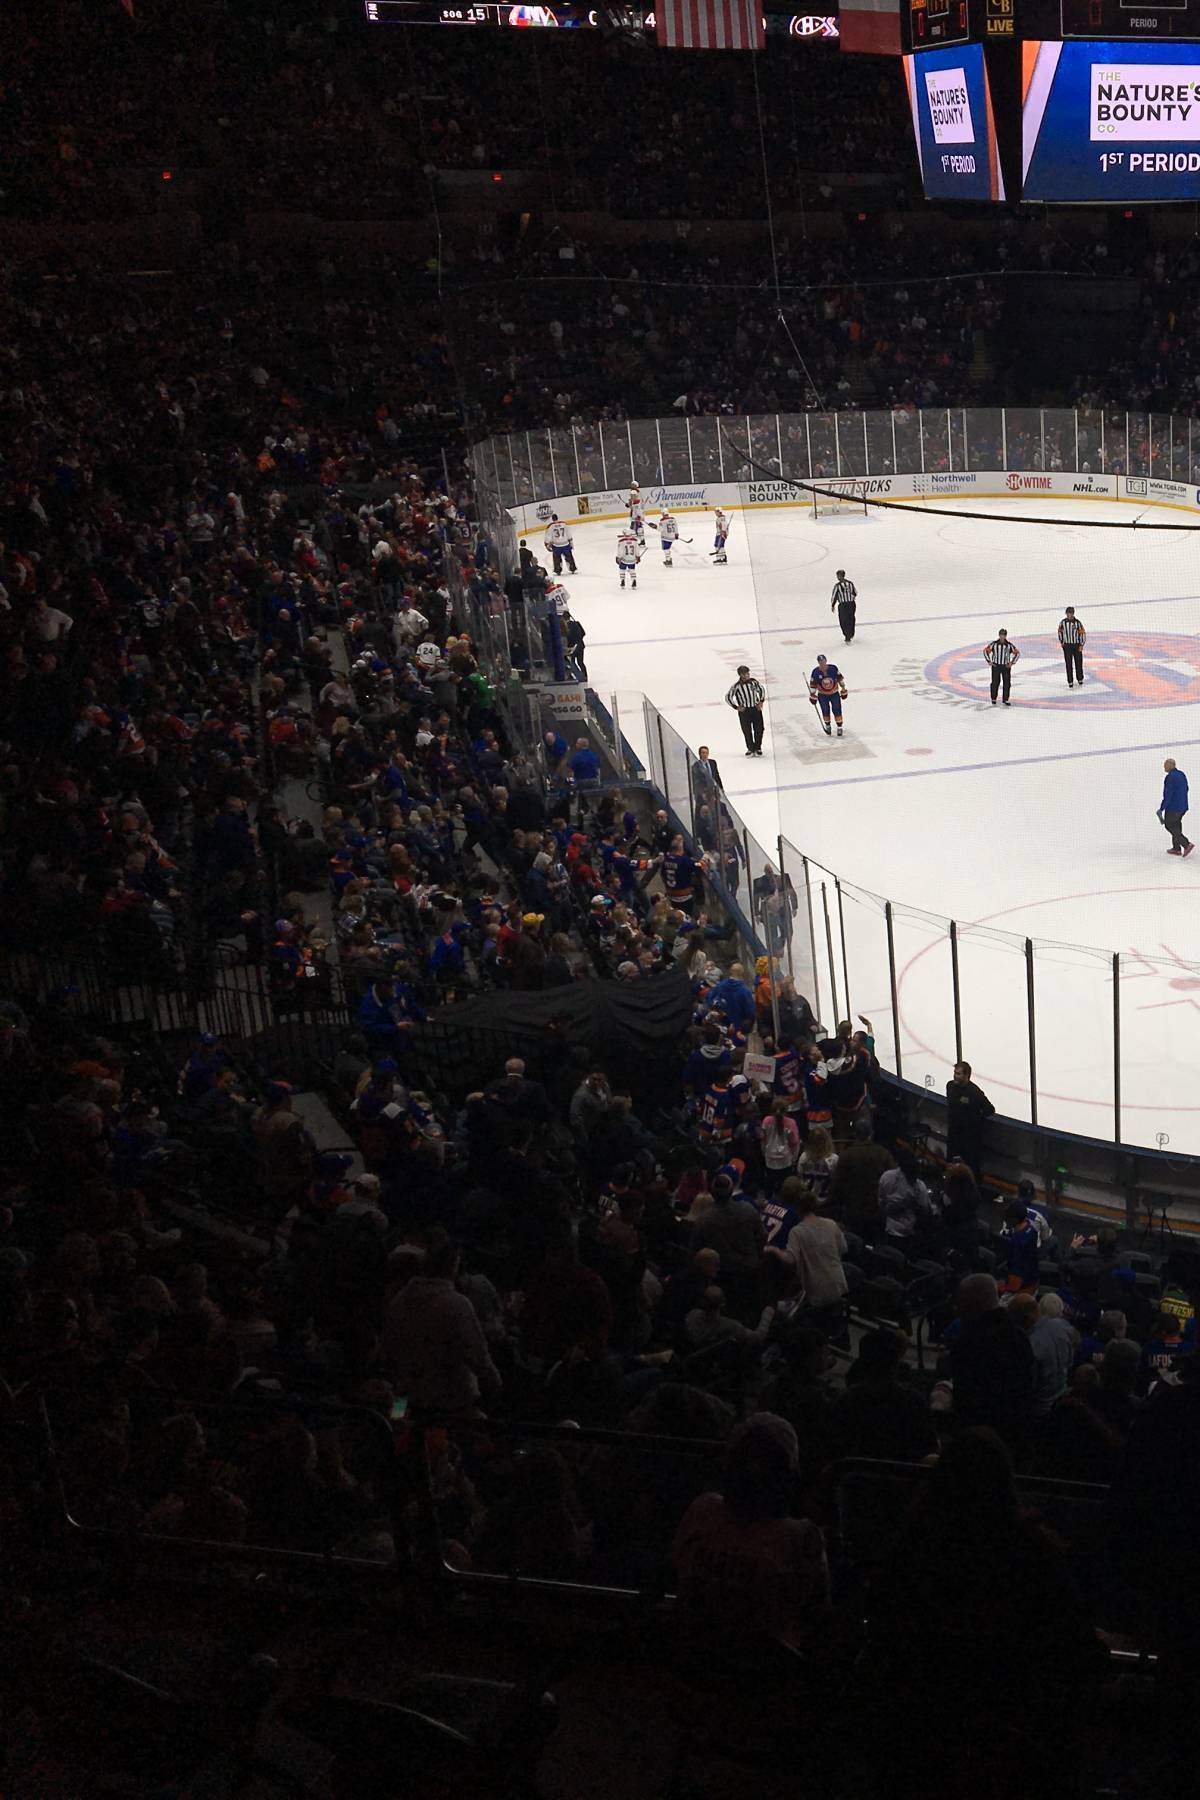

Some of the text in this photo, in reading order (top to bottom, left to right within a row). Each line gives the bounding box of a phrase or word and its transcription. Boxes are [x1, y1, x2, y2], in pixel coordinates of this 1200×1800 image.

[443, 8, 485, 21] SOG 15
[987, 19, 1014, 31] LIVE
[1130, 18, 1158, 28] PERIOD
[1098, 71, 1121, 82] THE
[929, 86, 967, 107] NATURE'S
[932, 107, 964, 126] BOUNTY
[1097, 104, 1192, 121] BOUNTY
[1097, 124, 1118, 134] CO.
[950, 154, 976, 173] PERIOD
[1099, 152, 1200, 172] 1ST PERIOD
[931, 474, 977, 483] Northwell
[1006, 473, 1052, 491] SHOWTIME
[931, 484, 960, 493] Health
[651, 487, 707, 504] Paramount
[749, 491, 798, 503] BOUNTY
[553, 527, 565, 538] 37
[624, 545, 635, 556] 13
[423, 647, 433, 655] 24
[570, 705, 582, 713] GO
